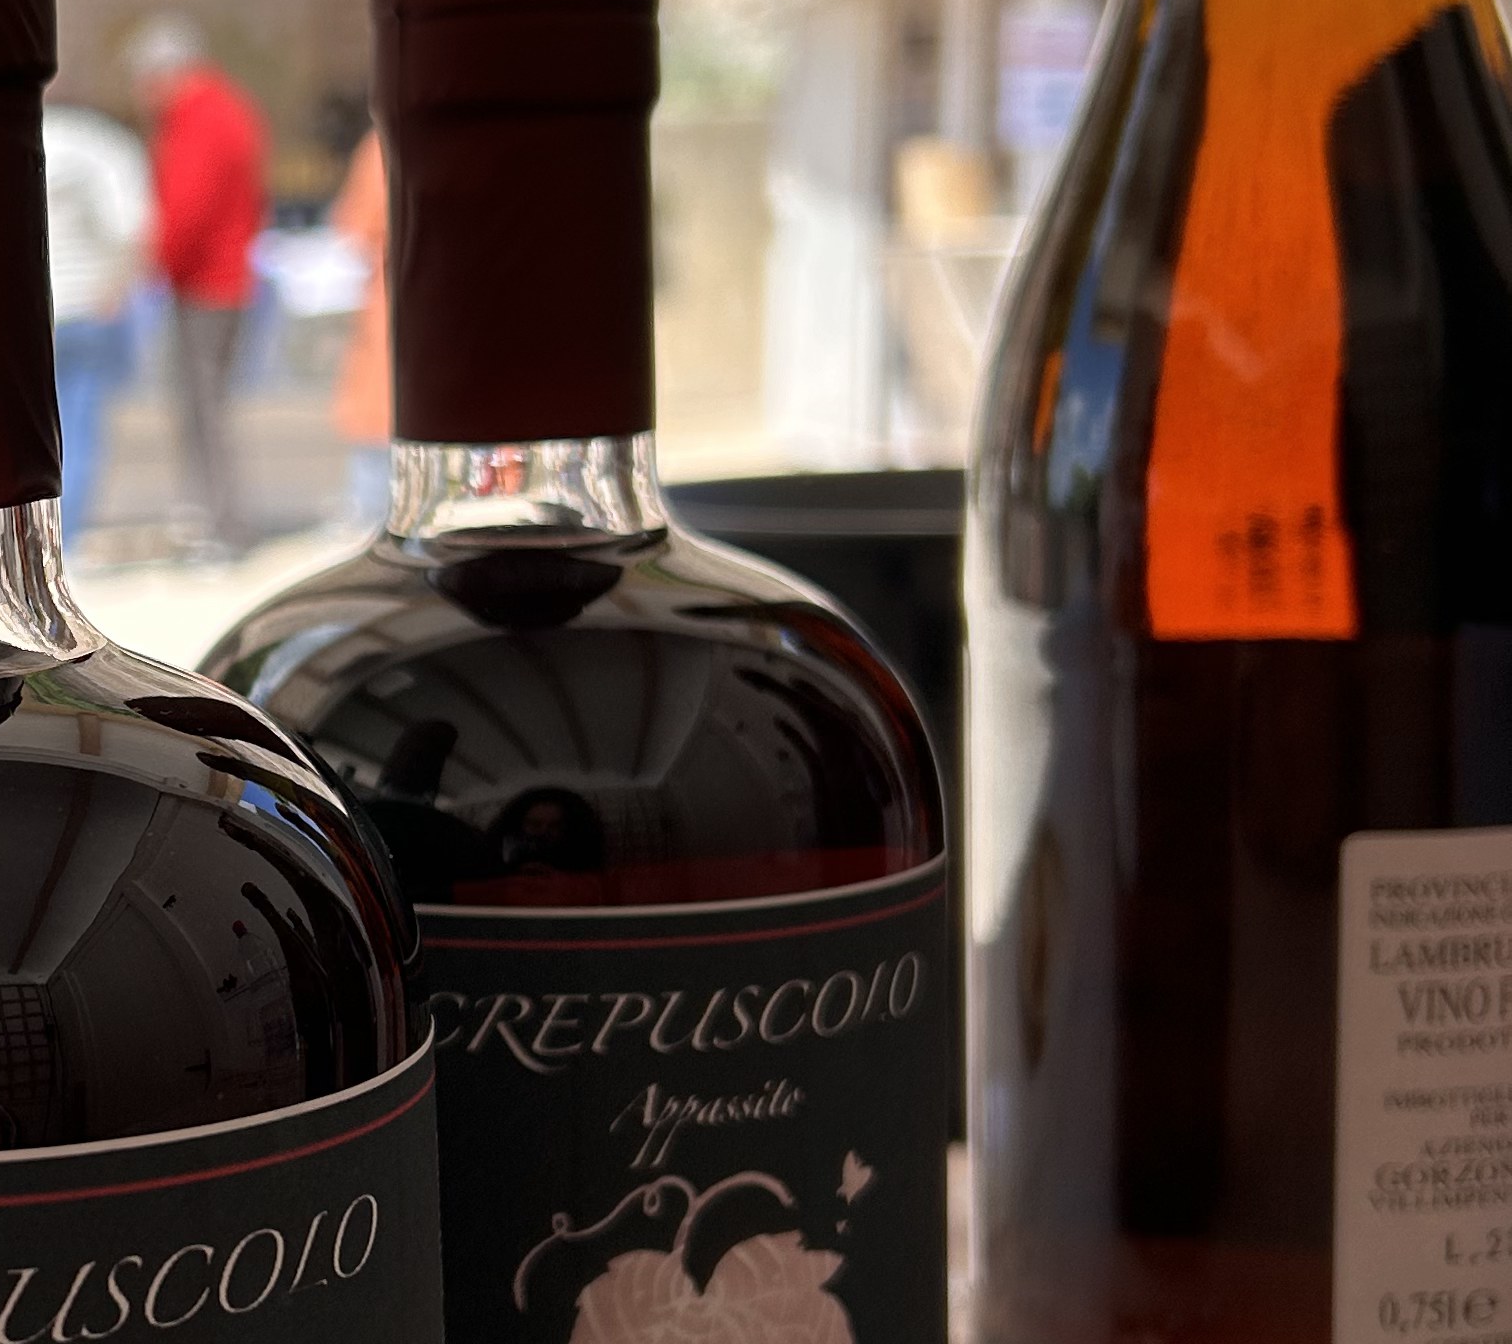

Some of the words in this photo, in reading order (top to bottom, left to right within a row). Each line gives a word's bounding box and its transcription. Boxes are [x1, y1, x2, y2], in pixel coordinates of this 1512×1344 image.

[428, 952, 923, 1074] CREPUSCOLO
[1396, 976, 1491, 1026] VINO
[608, 1077, 807, 1171] Appassito
